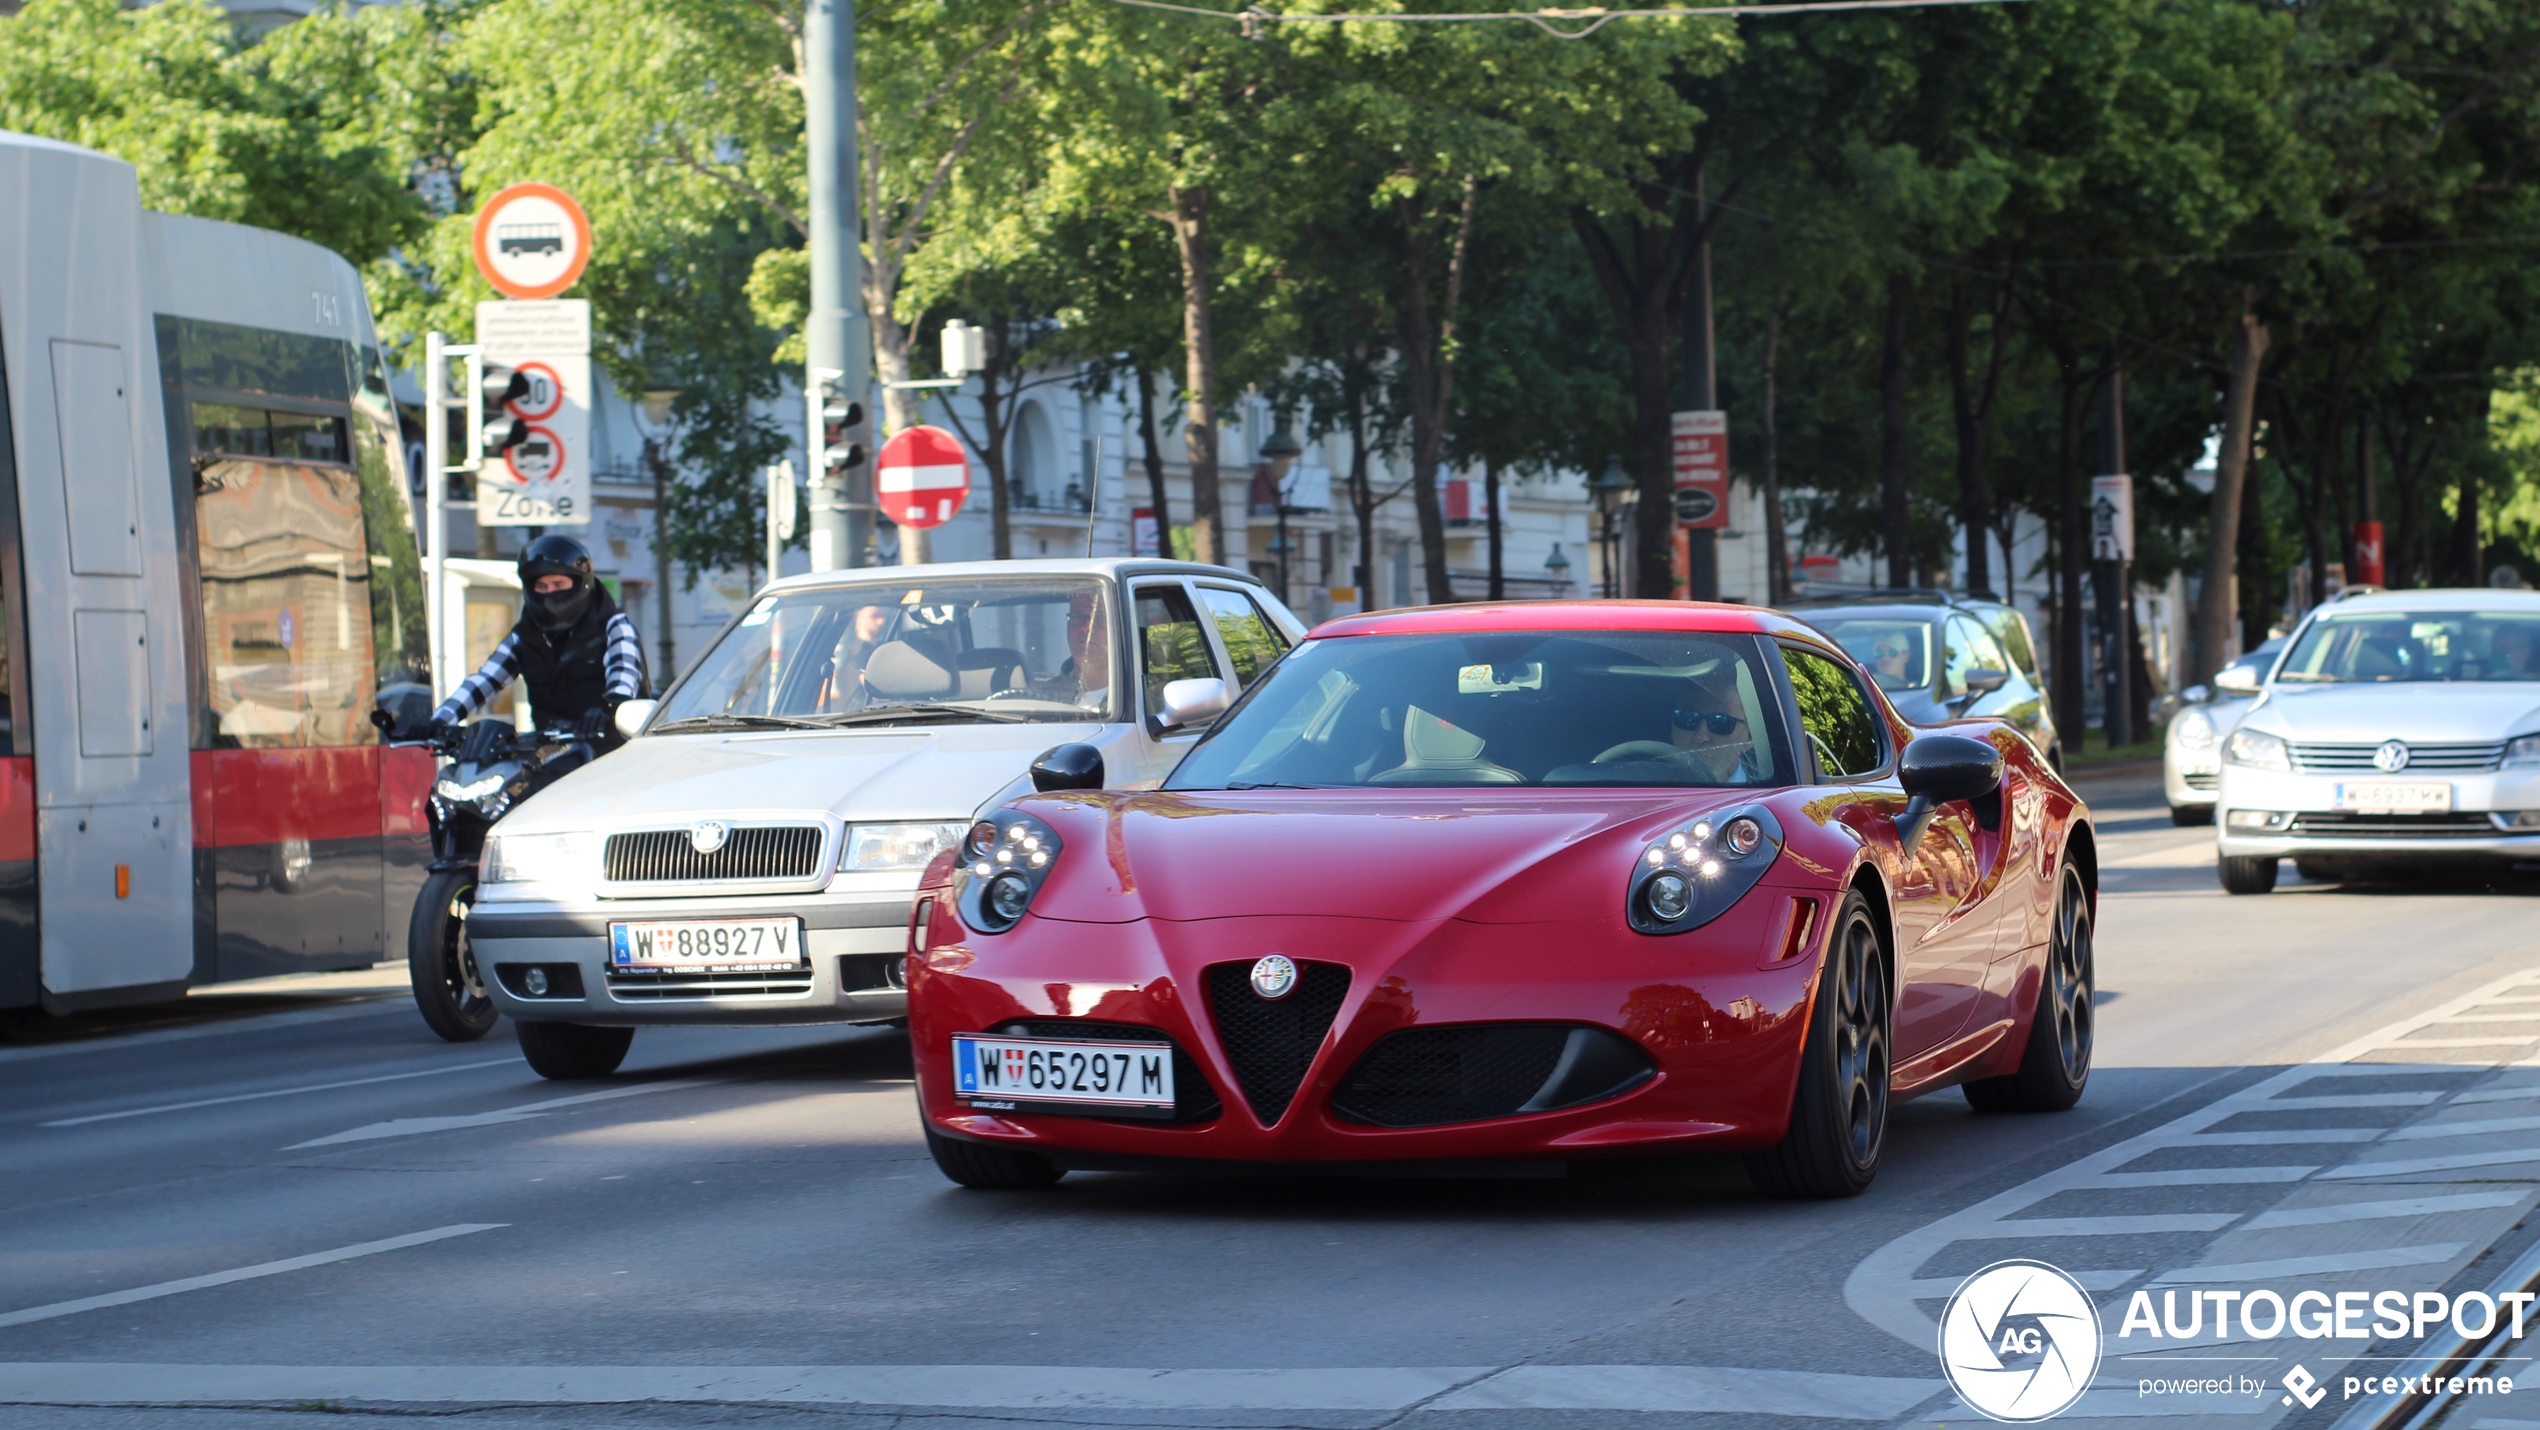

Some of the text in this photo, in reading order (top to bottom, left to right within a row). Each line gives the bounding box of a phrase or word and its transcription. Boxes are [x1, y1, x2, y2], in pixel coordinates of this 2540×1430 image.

[635, 926, 788, 958] W 88927 V
[618, 949, 628, 959] A
[964, 1073, 975, 1085] A
[979, 1048, 1162, 1095] W 65297 M
